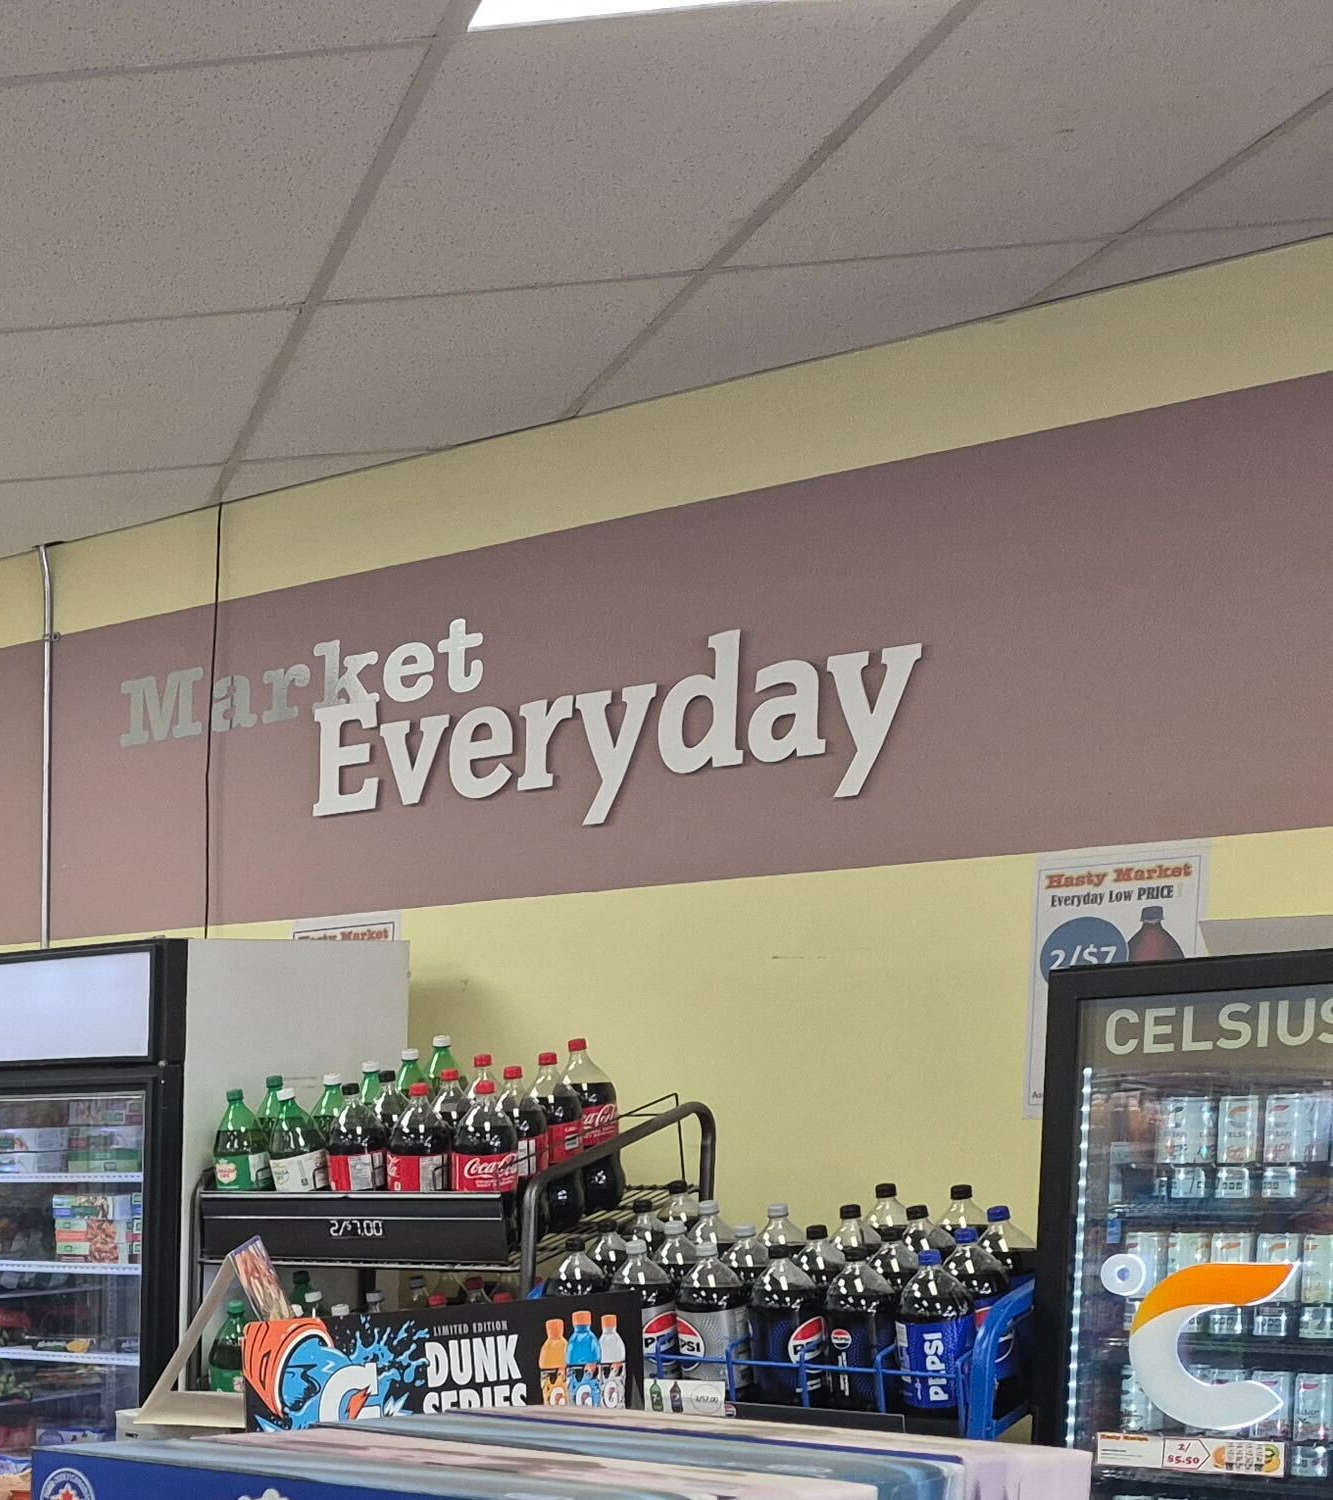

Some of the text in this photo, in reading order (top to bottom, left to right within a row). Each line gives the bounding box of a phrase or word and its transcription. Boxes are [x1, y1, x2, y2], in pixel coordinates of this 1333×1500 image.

[120, 618, 484, 747] Market
[312, 629, 923, 826] Everyday
[1044, 863, 1193, 890] Hasty Market
[1050, 885, 1175, 908] Everyday Low PRICE
[433, 1319, 509, 1338] LIMITED EDITION
[424, 1333, 523, 1388] DUNK
